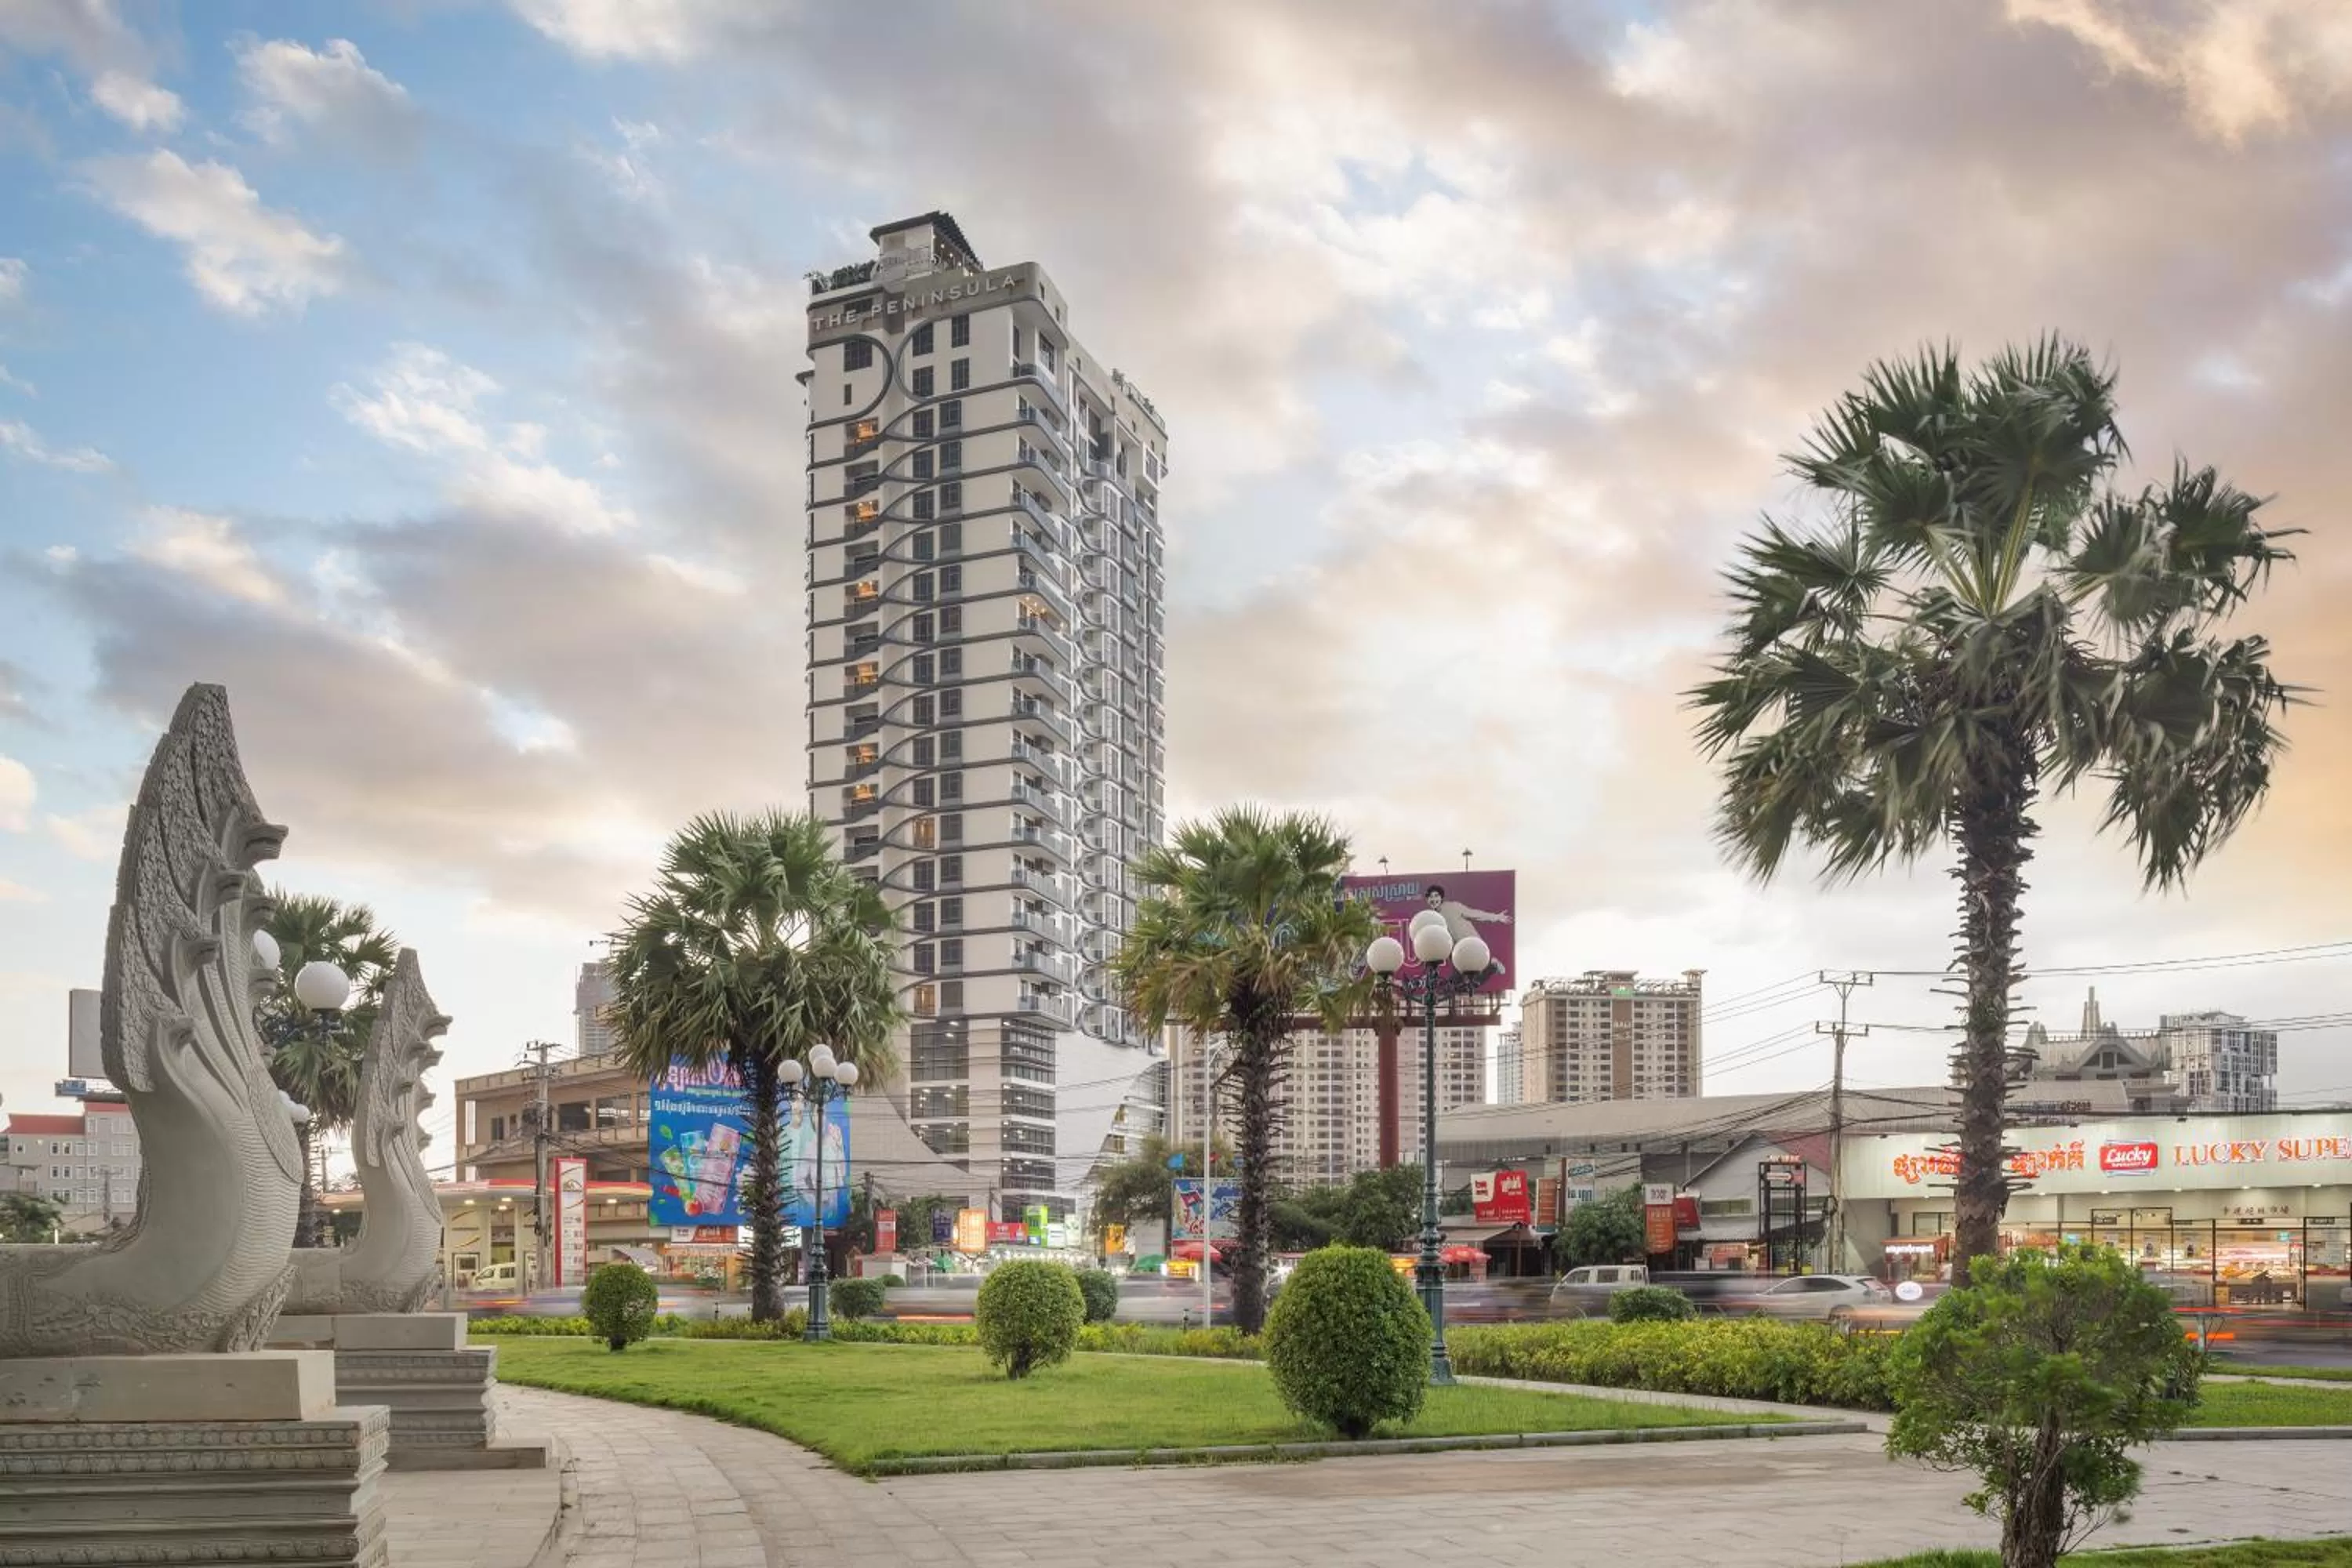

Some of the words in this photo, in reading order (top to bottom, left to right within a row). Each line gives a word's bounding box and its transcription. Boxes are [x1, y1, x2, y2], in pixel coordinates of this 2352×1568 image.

[811, 309, 858, 331] THE
[870, 274, 1017, 319] PENINSULA
[2105, 1145, 2152, 1167] Lucky
[2173, 1140, 2269, 1167] LUCKY
[2277, 1135, 2352, 1163] SUPE
